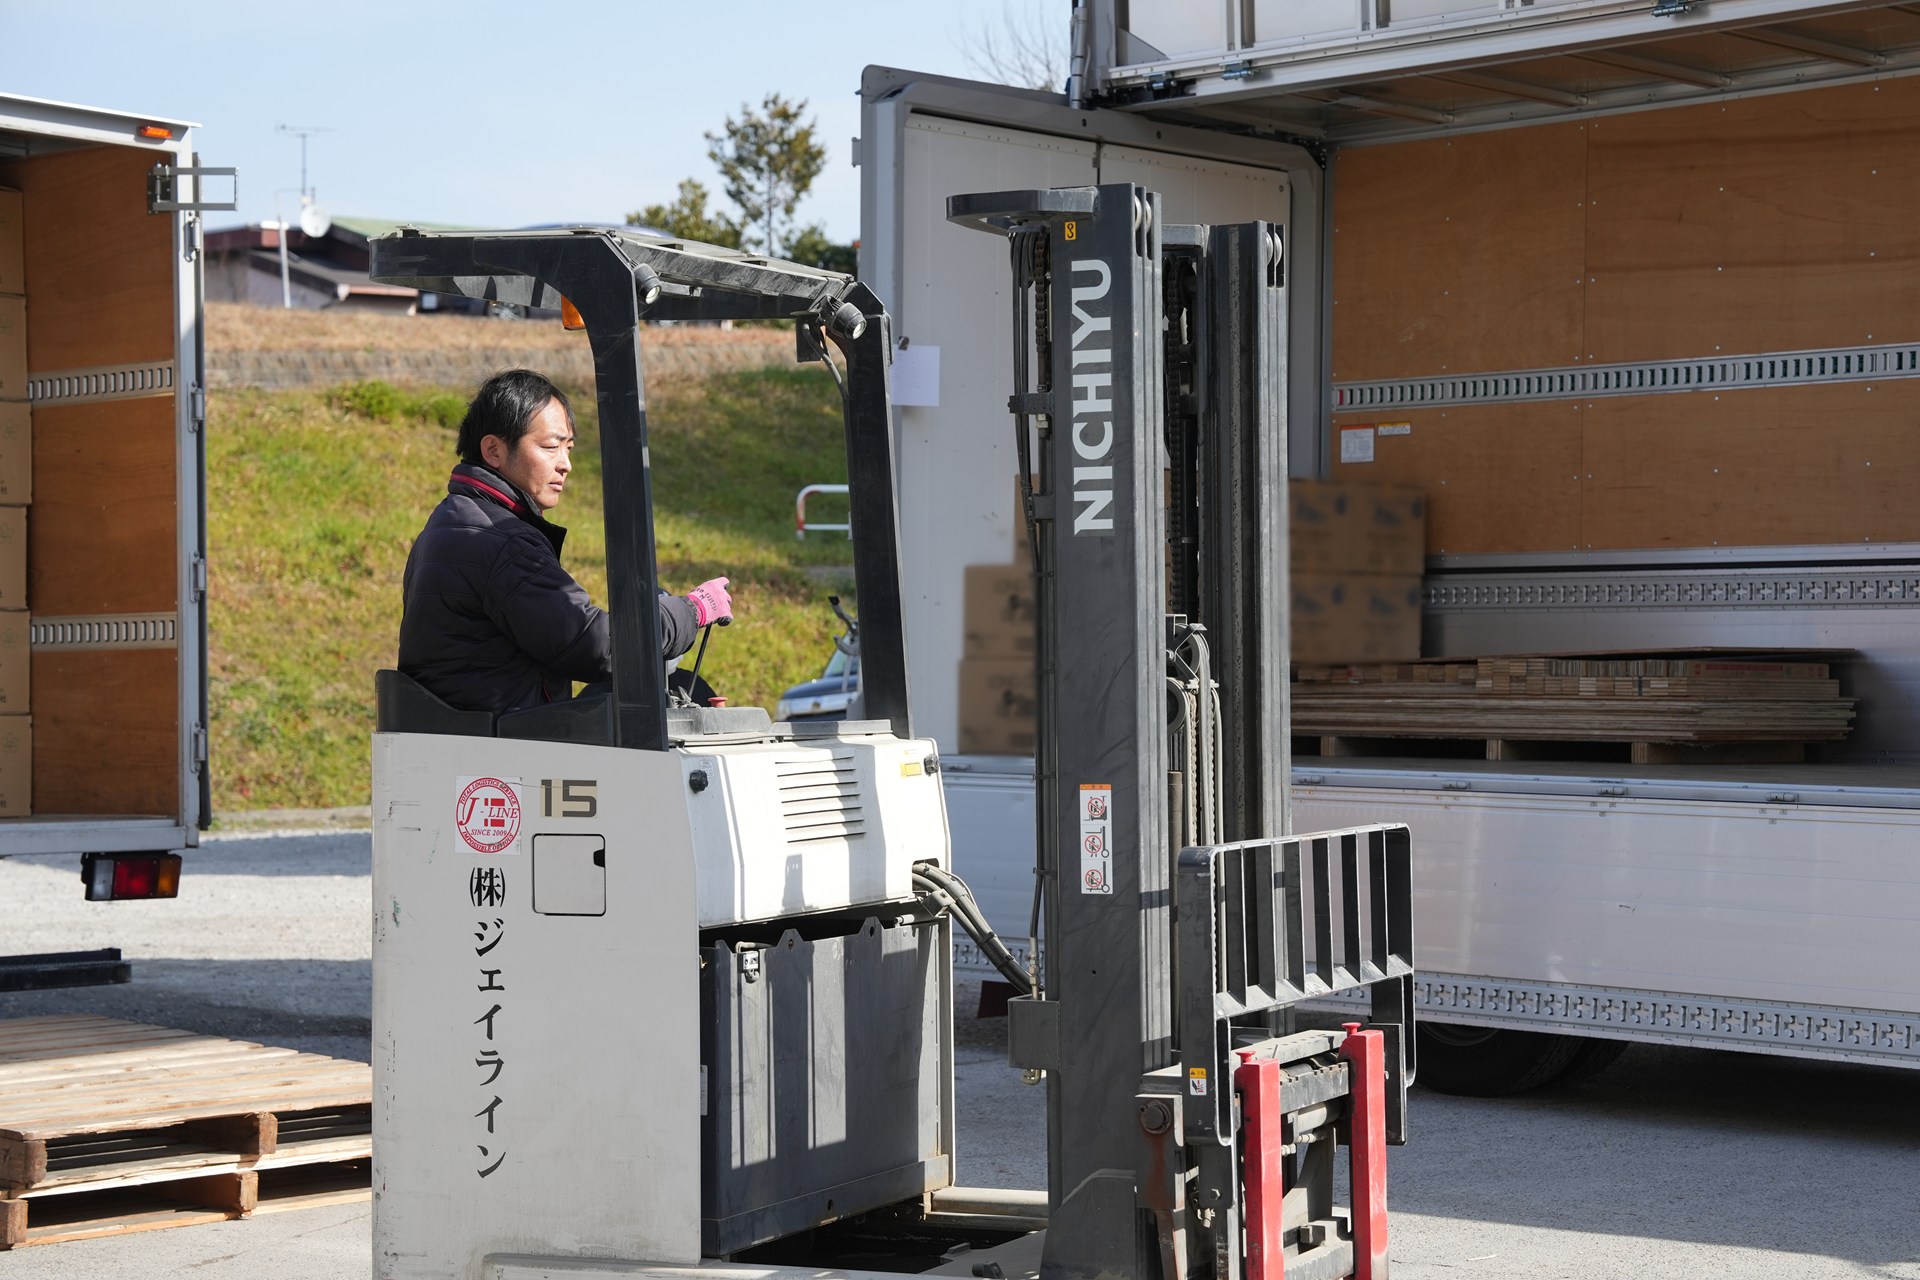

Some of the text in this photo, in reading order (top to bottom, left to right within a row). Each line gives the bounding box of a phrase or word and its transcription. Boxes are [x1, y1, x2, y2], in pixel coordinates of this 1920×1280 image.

[1071, 258, 1114, 536] NICHIYU
[460, 788, 473, 805] TOTAL
[472, 780, 499, 790] LOGISTICS
[541, 779, 597, 818] 15
[462, 831, 491, 851] IMPOSSIBLE
[471, 828, 507, 837] SINCE 2009
